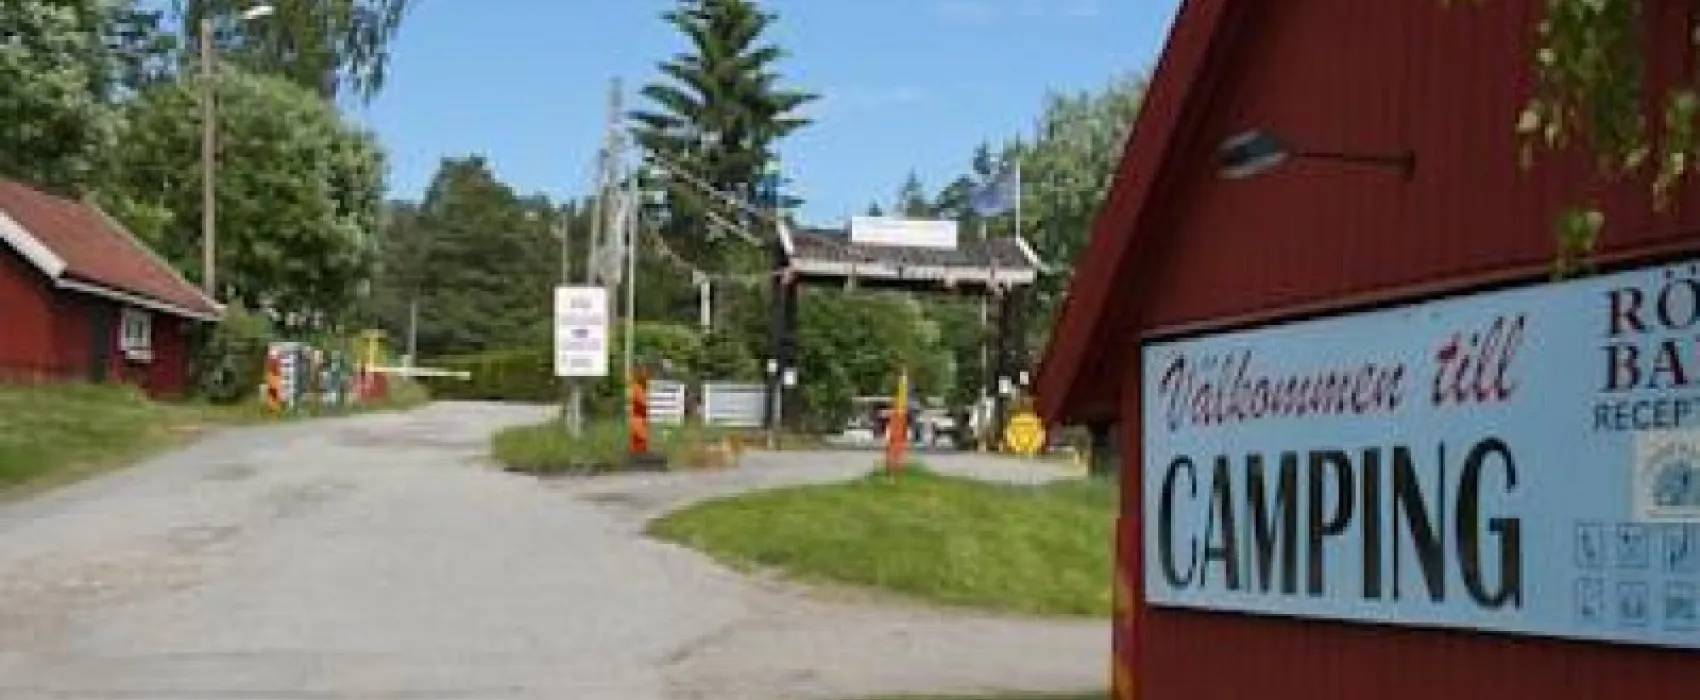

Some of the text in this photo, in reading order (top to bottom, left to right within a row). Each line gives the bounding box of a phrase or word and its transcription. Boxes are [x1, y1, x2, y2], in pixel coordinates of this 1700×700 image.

[1160, 313, 1526, 431] Välkommen till
[1600, 341, 1700, 392] BA
[1594, 398, 1700, 431] RECEP
[1158, 437, 1523, 610] CAMPING
